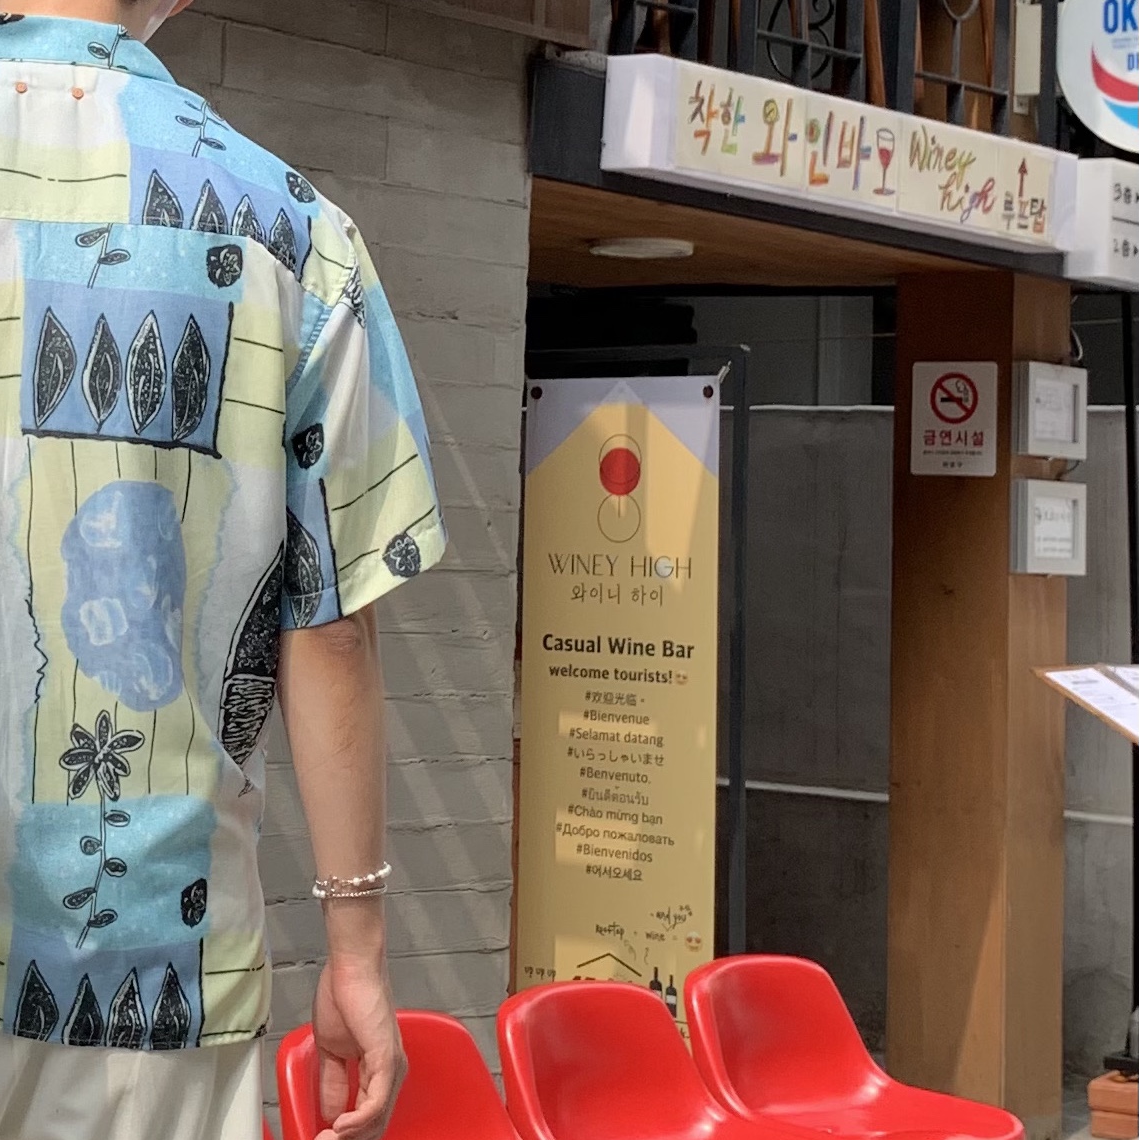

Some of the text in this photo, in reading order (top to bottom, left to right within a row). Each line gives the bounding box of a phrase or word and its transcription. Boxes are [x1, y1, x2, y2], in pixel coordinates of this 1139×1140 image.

[688, 79, 872, 191] 착한 와인바
[909, 125, 977, 191] Winey
[938, 171, 997, 224] high
[1002, 190, 1047, 234] 루프탑
[923, 429, 984, 447] 금연시설
[548, 552, 692, 579] WINEY HIGH
[570, 582, 663, 607] 와이니 하이
[542, 633, 695, 659] Casual Wine Bar
[549, 664, 673, 684] welcome tourists!
[583, 709, 650, 725] #Bienvenue
[569, 727, 664, 748] #Selamat datang
[556, 822, 675, 846] #Добро пожаловать
[576, 843, 653, 863] #Bienvenidos
[586, 864, 644, 881] #어서오세요
